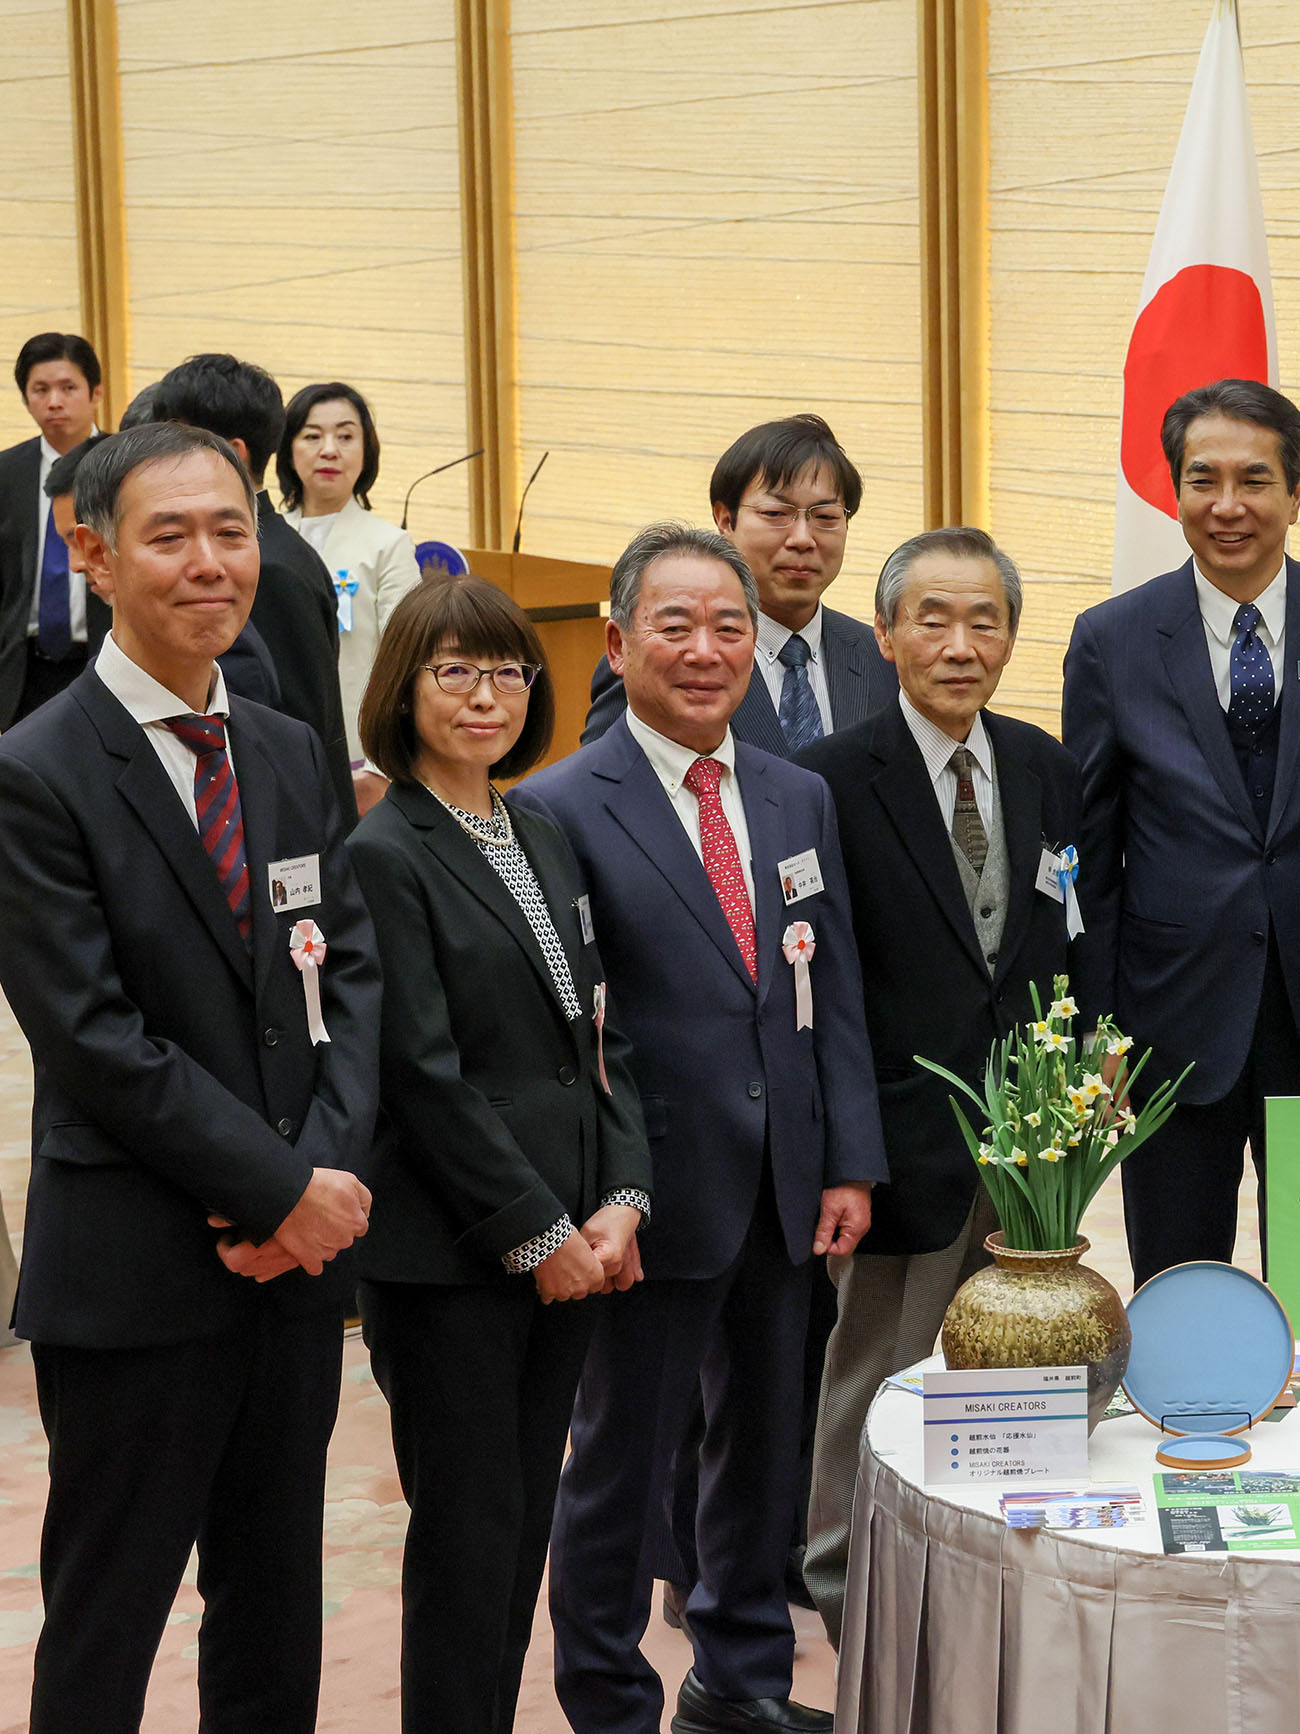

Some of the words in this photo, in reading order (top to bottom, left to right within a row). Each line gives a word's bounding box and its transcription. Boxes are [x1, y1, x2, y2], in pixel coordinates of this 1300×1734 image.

[965, 1403, 995, 1413] MISAKI
[997, 1401, 1047, 1412] CREATORS
[969, 1433, 996, 1442] 越前水仙
[992, 1459, 1026, 1468] CREATORS
